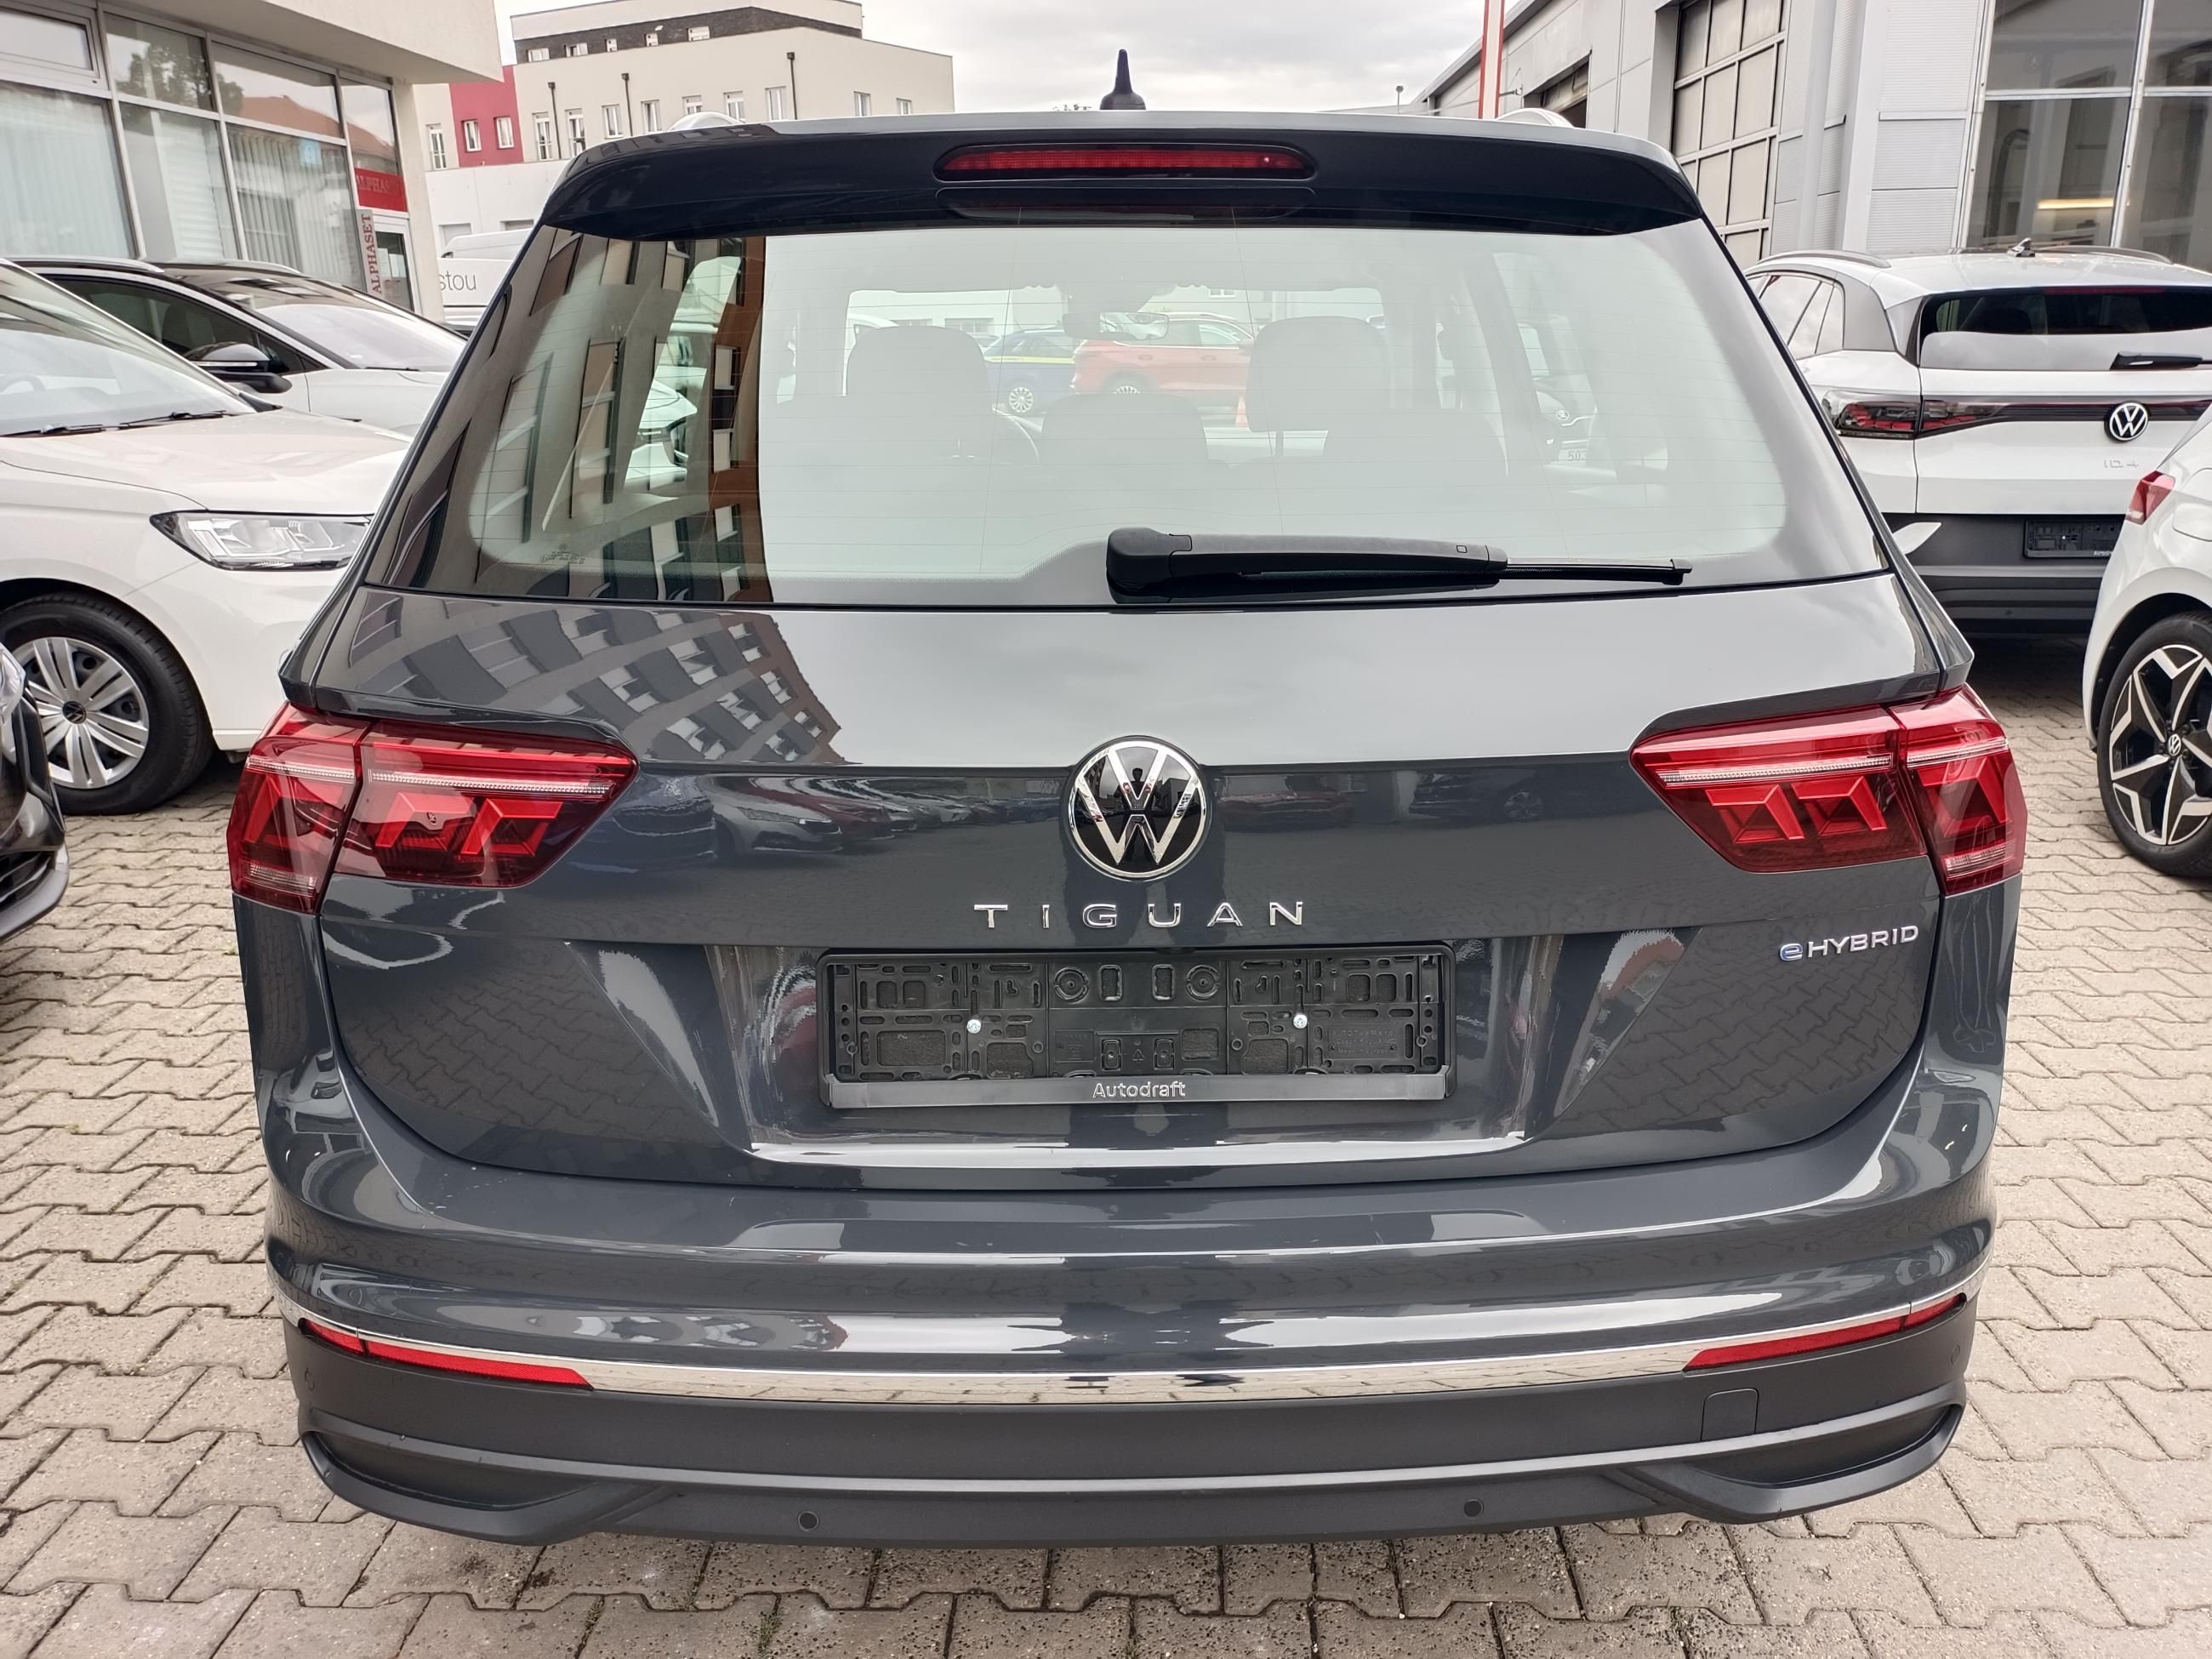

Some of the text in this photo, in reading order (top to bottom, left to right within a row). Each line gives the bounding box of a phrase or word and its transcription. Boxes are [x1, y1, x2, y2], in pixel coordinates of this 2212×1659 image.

[361, 214, 383, 294] ALPHASET
[438, 270, 477, 291] stou
[1070, 737, 1208, 880] VW
[973, 900, 1304, 930] TIGUAN
[1779, 924, 1920, 962] eHYBRID
[1092, 1080, 1187, 1099] Autodraft
